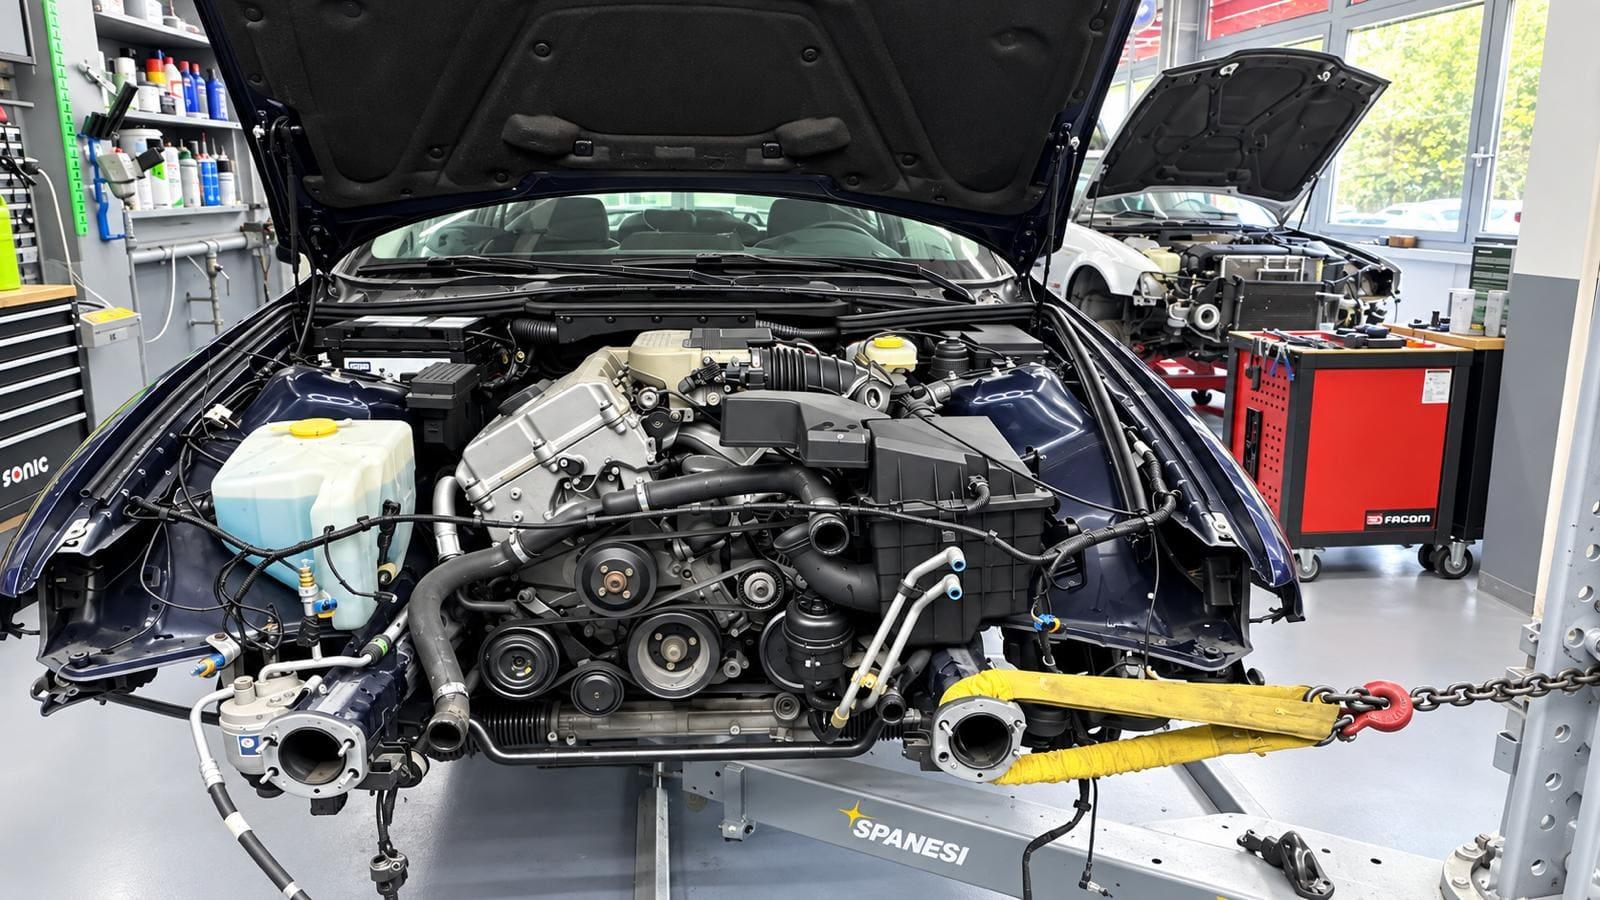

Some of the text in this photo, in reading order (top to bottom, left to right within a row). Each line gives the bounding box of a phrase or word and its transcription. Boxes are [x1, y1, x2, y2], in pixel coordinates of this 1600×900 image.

[2, 456, 49, 488] SONIC
[1384, 514, 1431, 524] FACOM
[853, 819, 970, 866] SPANESI
